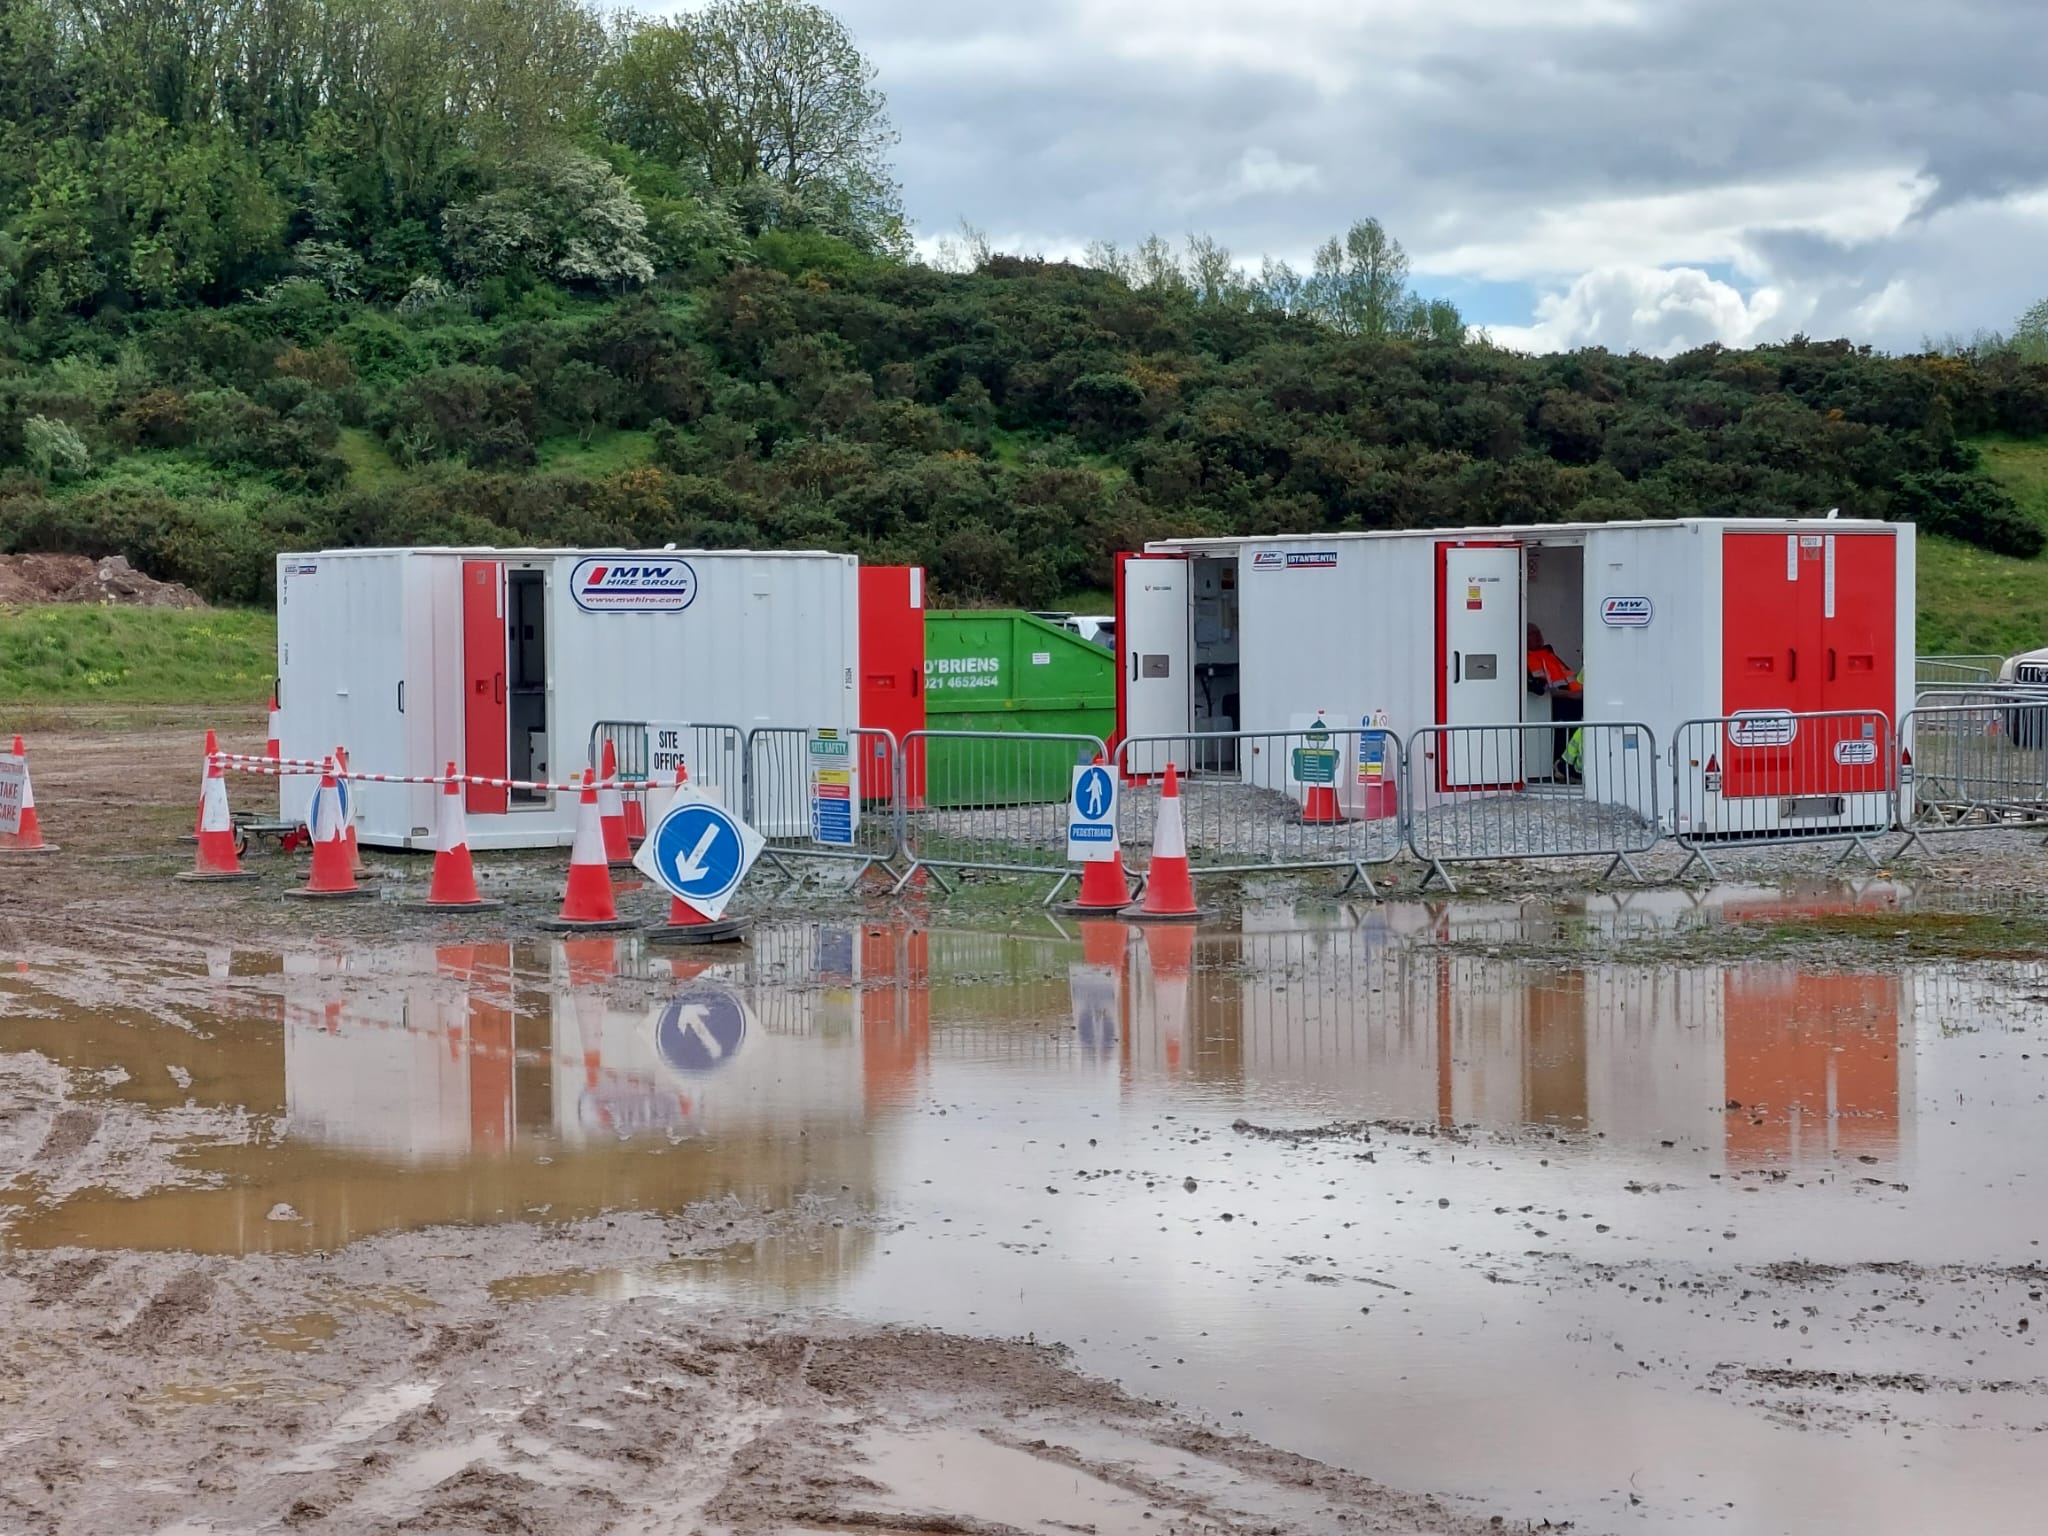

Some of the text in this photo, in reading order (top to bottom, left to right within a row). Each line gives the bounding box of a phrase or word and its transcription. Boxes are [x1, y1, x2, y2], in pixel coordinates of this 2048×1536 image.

[611, 567, 673, 578] MW
[924, 657, 999, 674] O'BRIENS
[947, 675, 999, 688] 4652454
[658, 731, 679, 749] SITE
[1072, 827, 1111, 838] PEDESTRIANS
